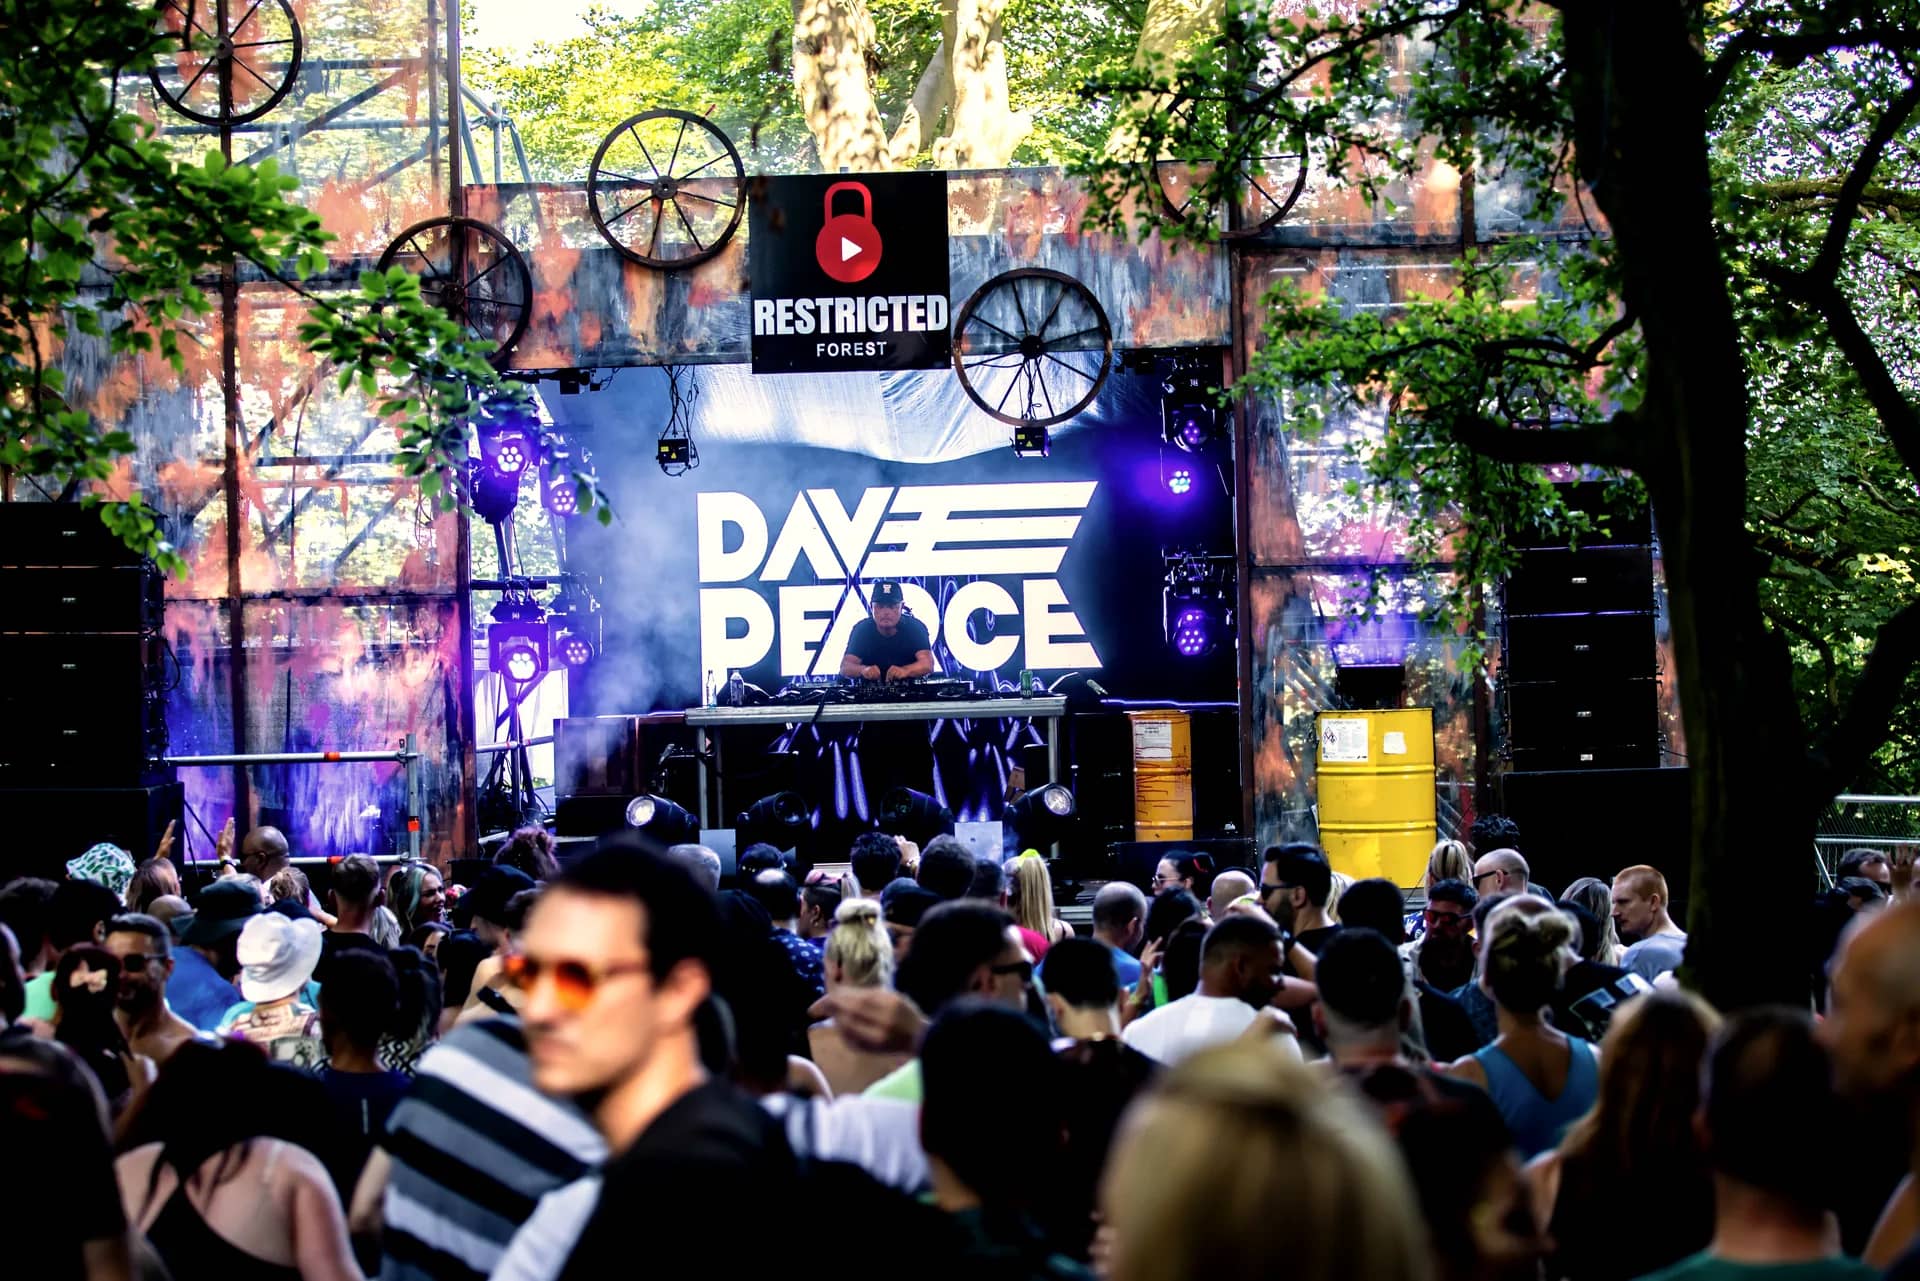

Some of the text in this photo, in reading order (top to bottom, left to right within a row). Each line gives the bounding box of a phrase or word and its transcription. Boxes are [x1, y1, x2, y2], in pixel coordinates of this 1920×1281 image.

[754, 295, 948, 335] RESTRICTED
[816, 341, 887, 357] FOREST
[697, 481, 1099, 582] DAVE
